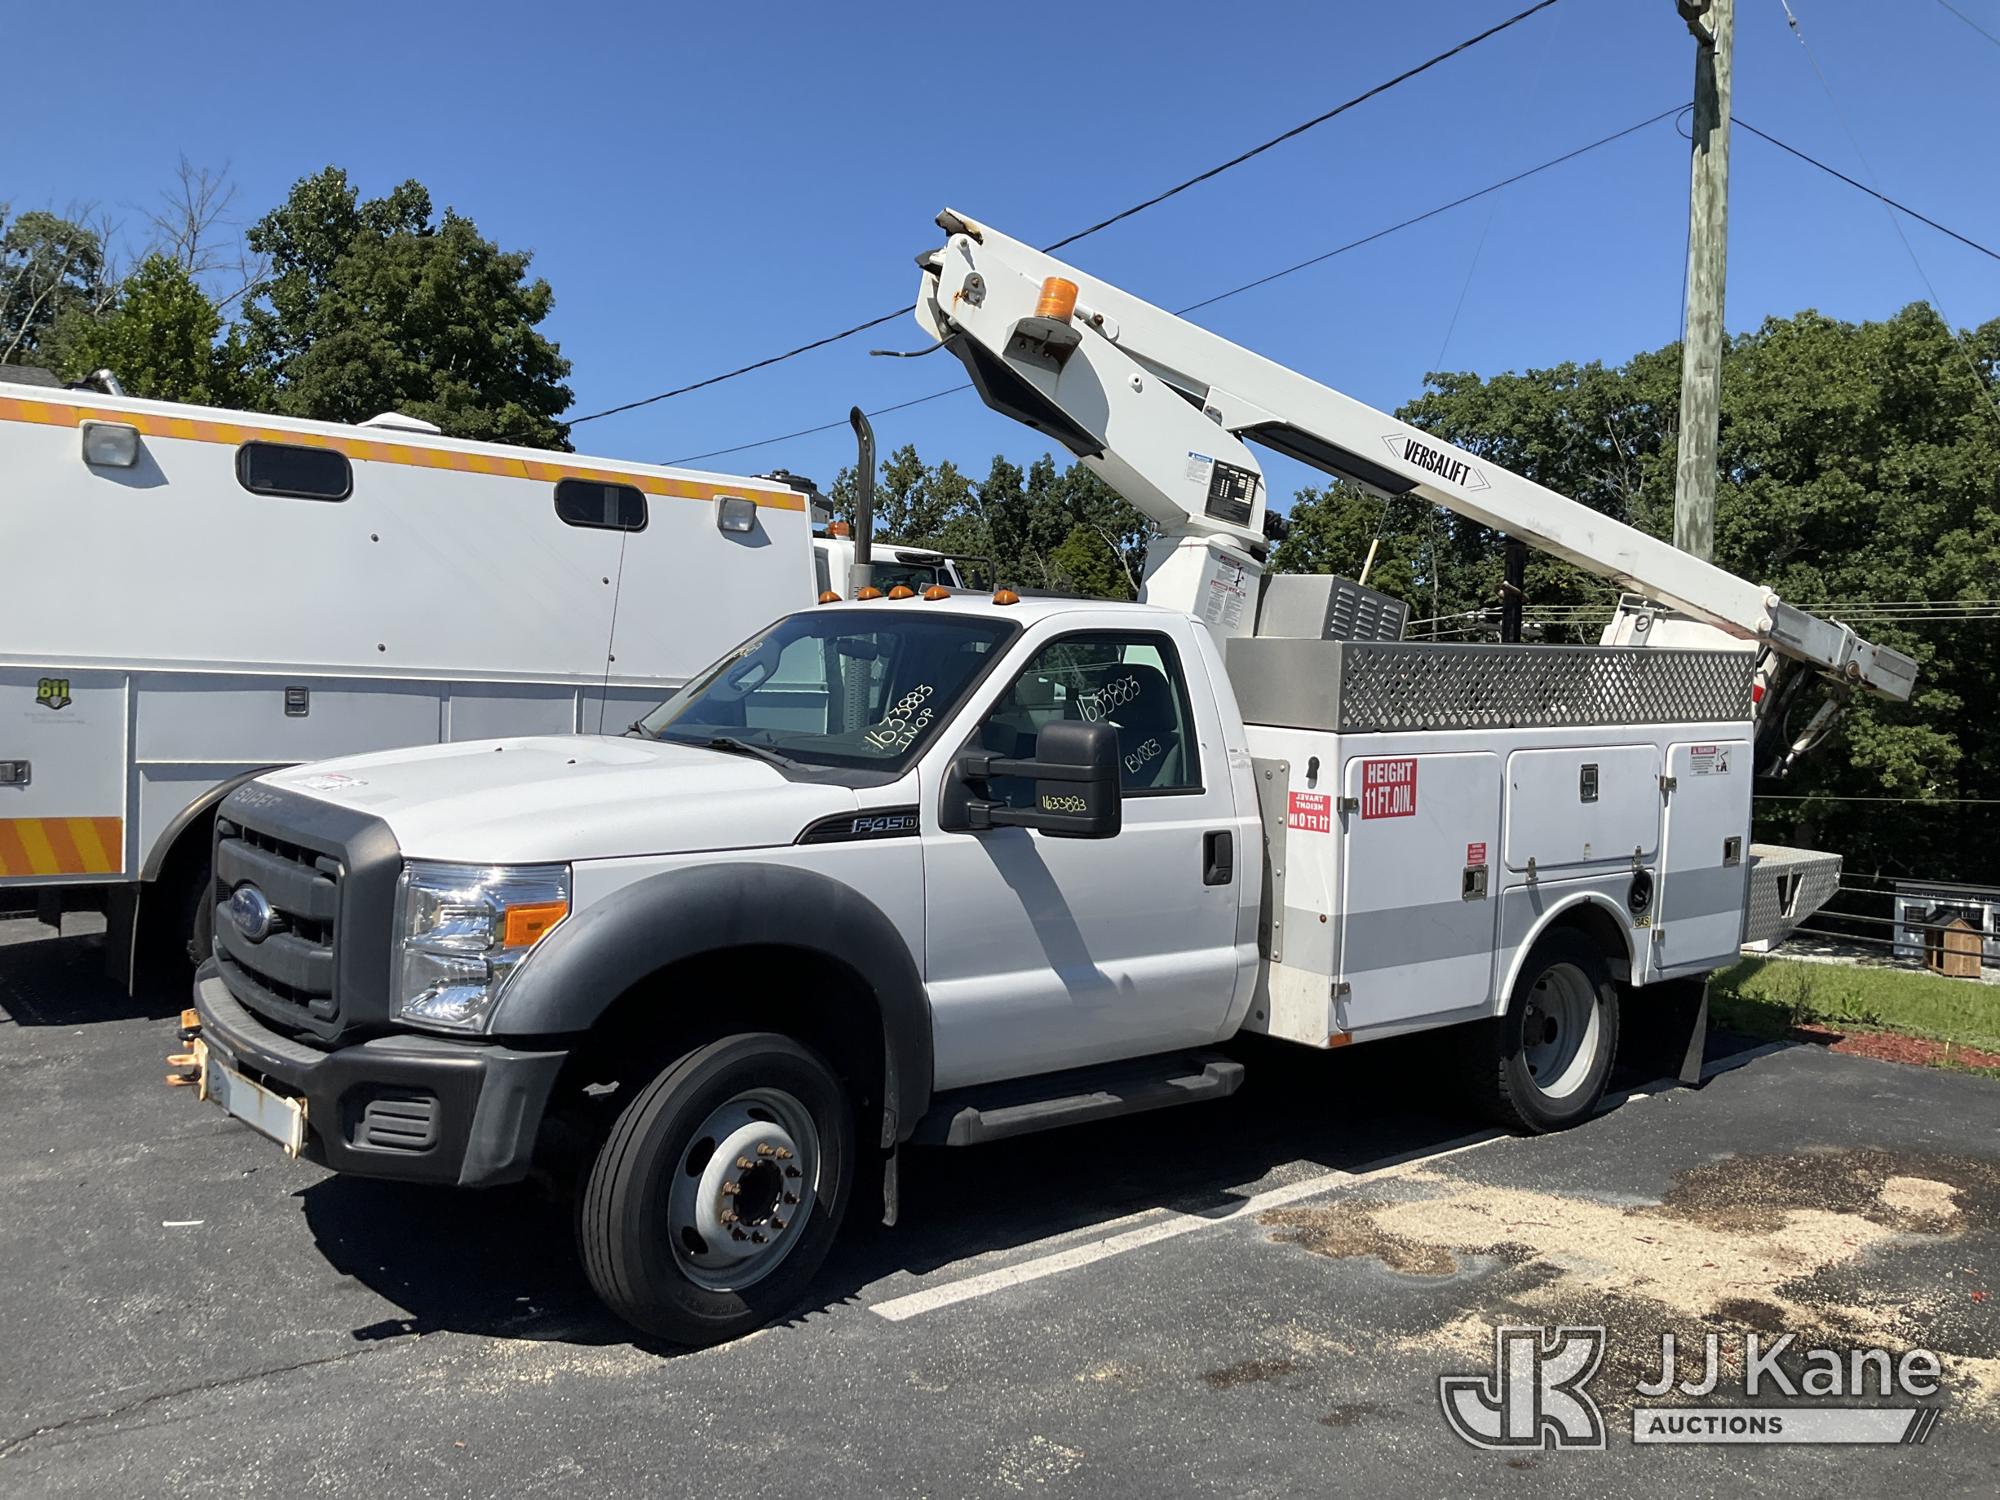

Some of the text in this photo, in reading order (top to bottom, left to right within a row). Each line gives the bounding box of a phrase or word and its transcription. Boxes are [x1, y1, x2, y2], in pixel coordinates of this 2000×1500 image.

[1403, 438, 1471, 486] VERSALIFT
[38, 678, 69, 698] 811
[1076, 675, 1141, 722] 1633883
[864, 684, 933, 750] 1633883
[896, 708, 934, 753] INOP
[1367, 762, 1413, 784] HEIGHT
[1042, 795, 1087, 813] 1633883
[1634, 916, 1650, 928] GAS
